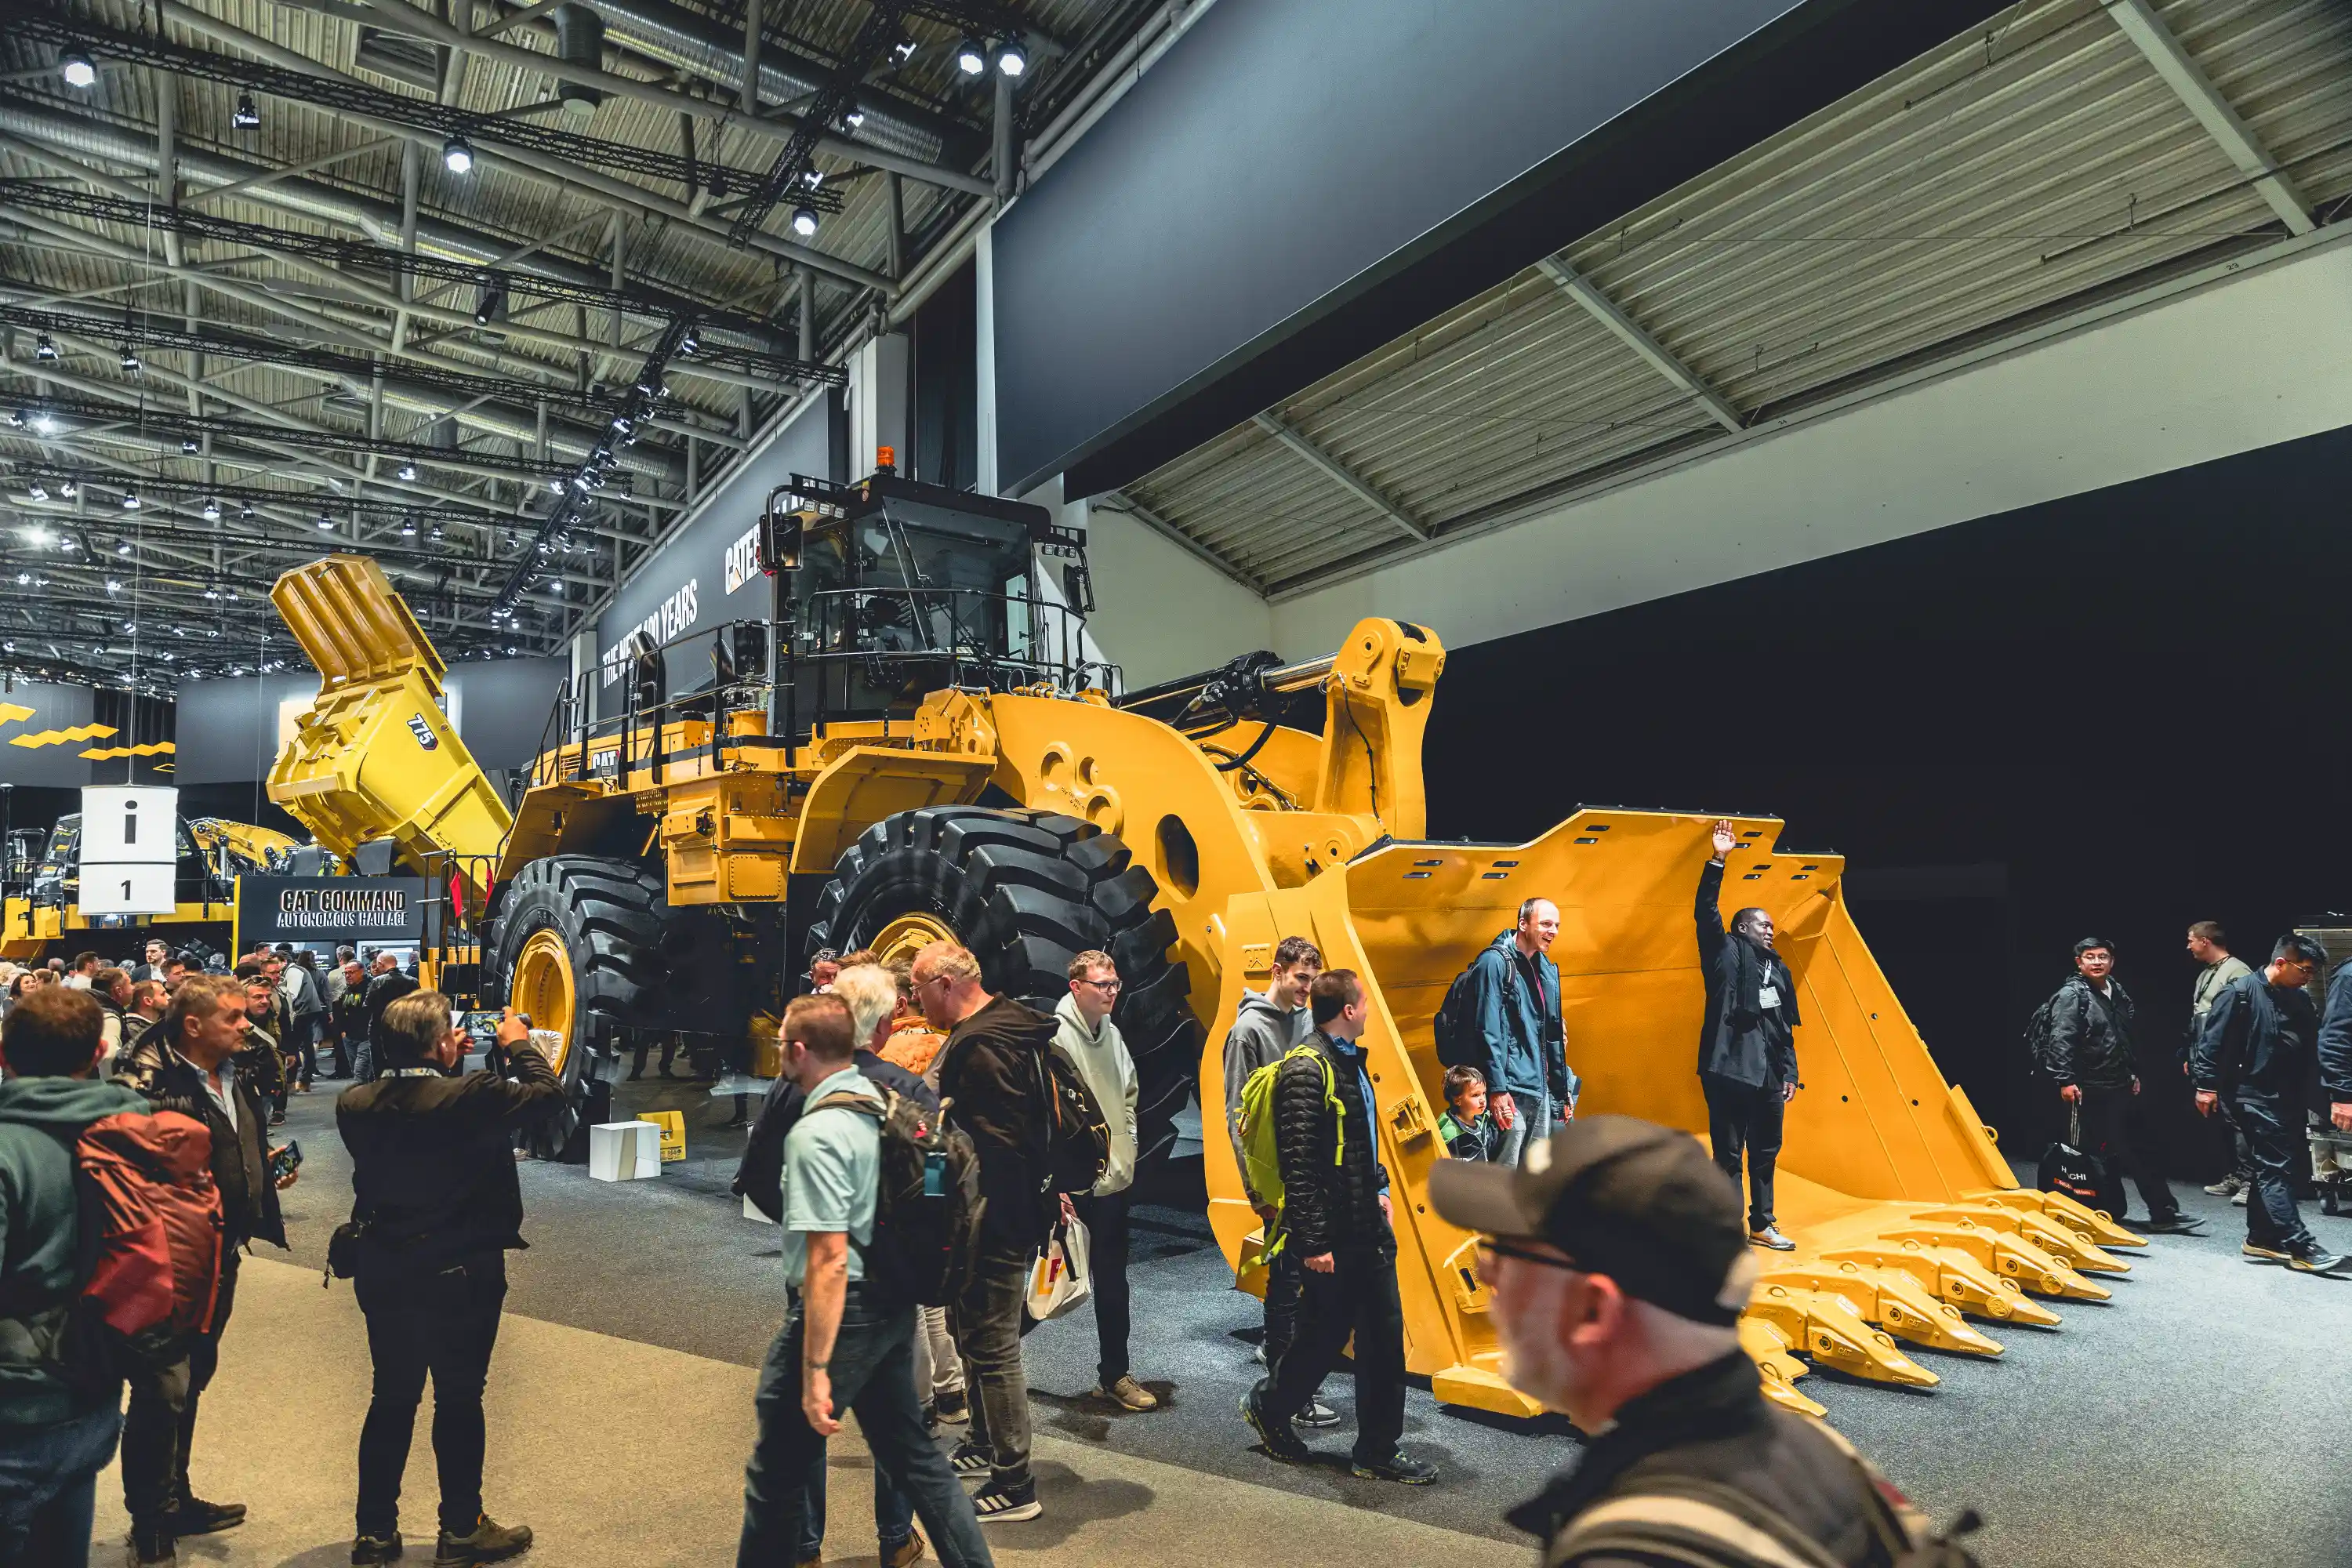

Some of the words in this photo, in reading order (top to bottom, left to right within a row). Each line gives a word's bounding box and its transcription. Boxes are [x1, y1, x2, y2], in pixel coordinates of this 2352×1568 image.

[602, 644, 619, 689] THE
[661, 578, 699, 644] YEARS
[406, 712, 437, 746] 775
[591, 750, 618, 769] CAT
[121, 880, 132, 901] 1
[281, 890, 314, 912] CAT
[320, 890, 407, 912] COMMAND
[277, 912, 357, 927] AUTONOMOUS
[358, 912, 408, 927] HAULAGE
